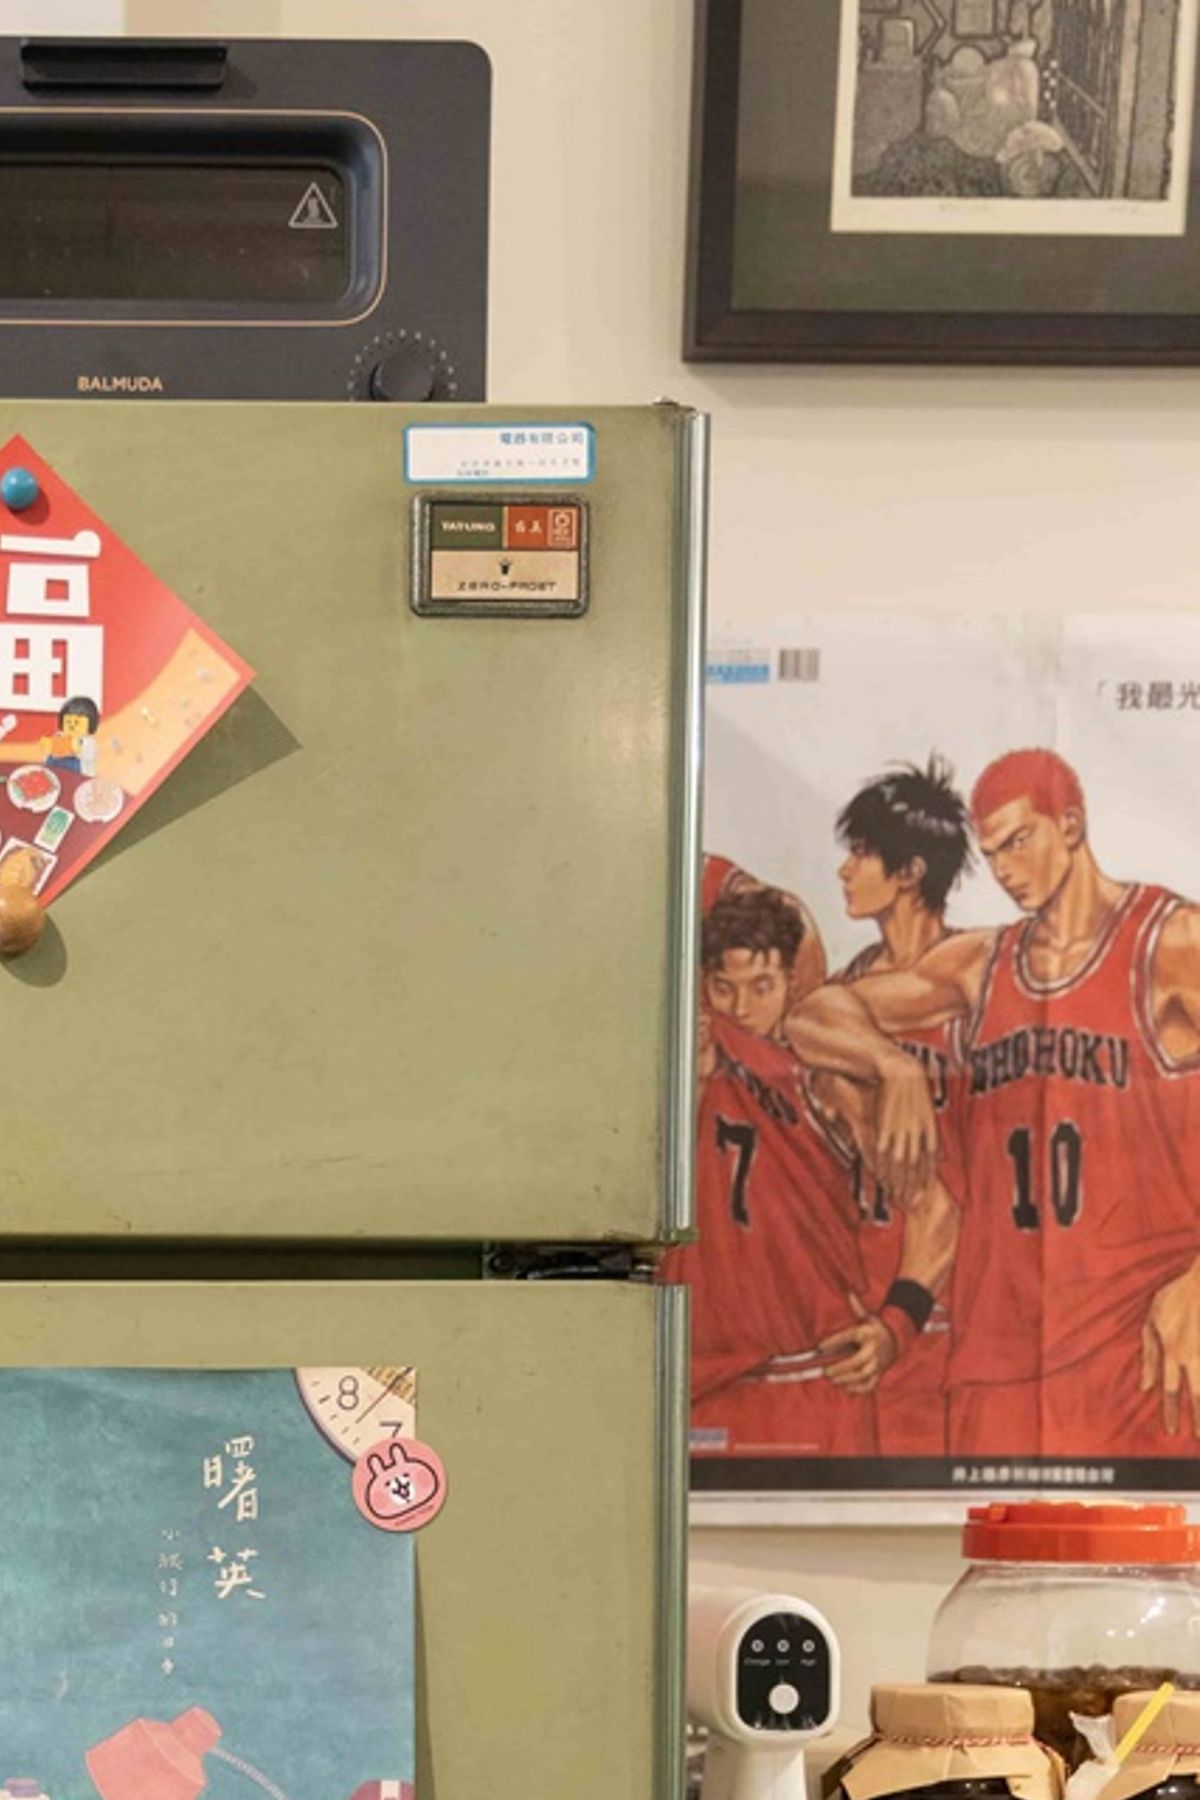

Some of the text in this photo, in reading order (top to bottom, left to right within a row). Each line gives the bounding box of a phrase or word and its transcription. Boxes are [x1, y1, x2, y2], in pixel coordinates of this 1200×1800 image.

[78, 376, 162, 391] BALMUDA
[441, 521, 496, 532] TATUNG
[714, 1114, 757, 1227] 7
[1006, 1120, 1084, 1231] 10
[337, 1374, 360, 1411] 8
